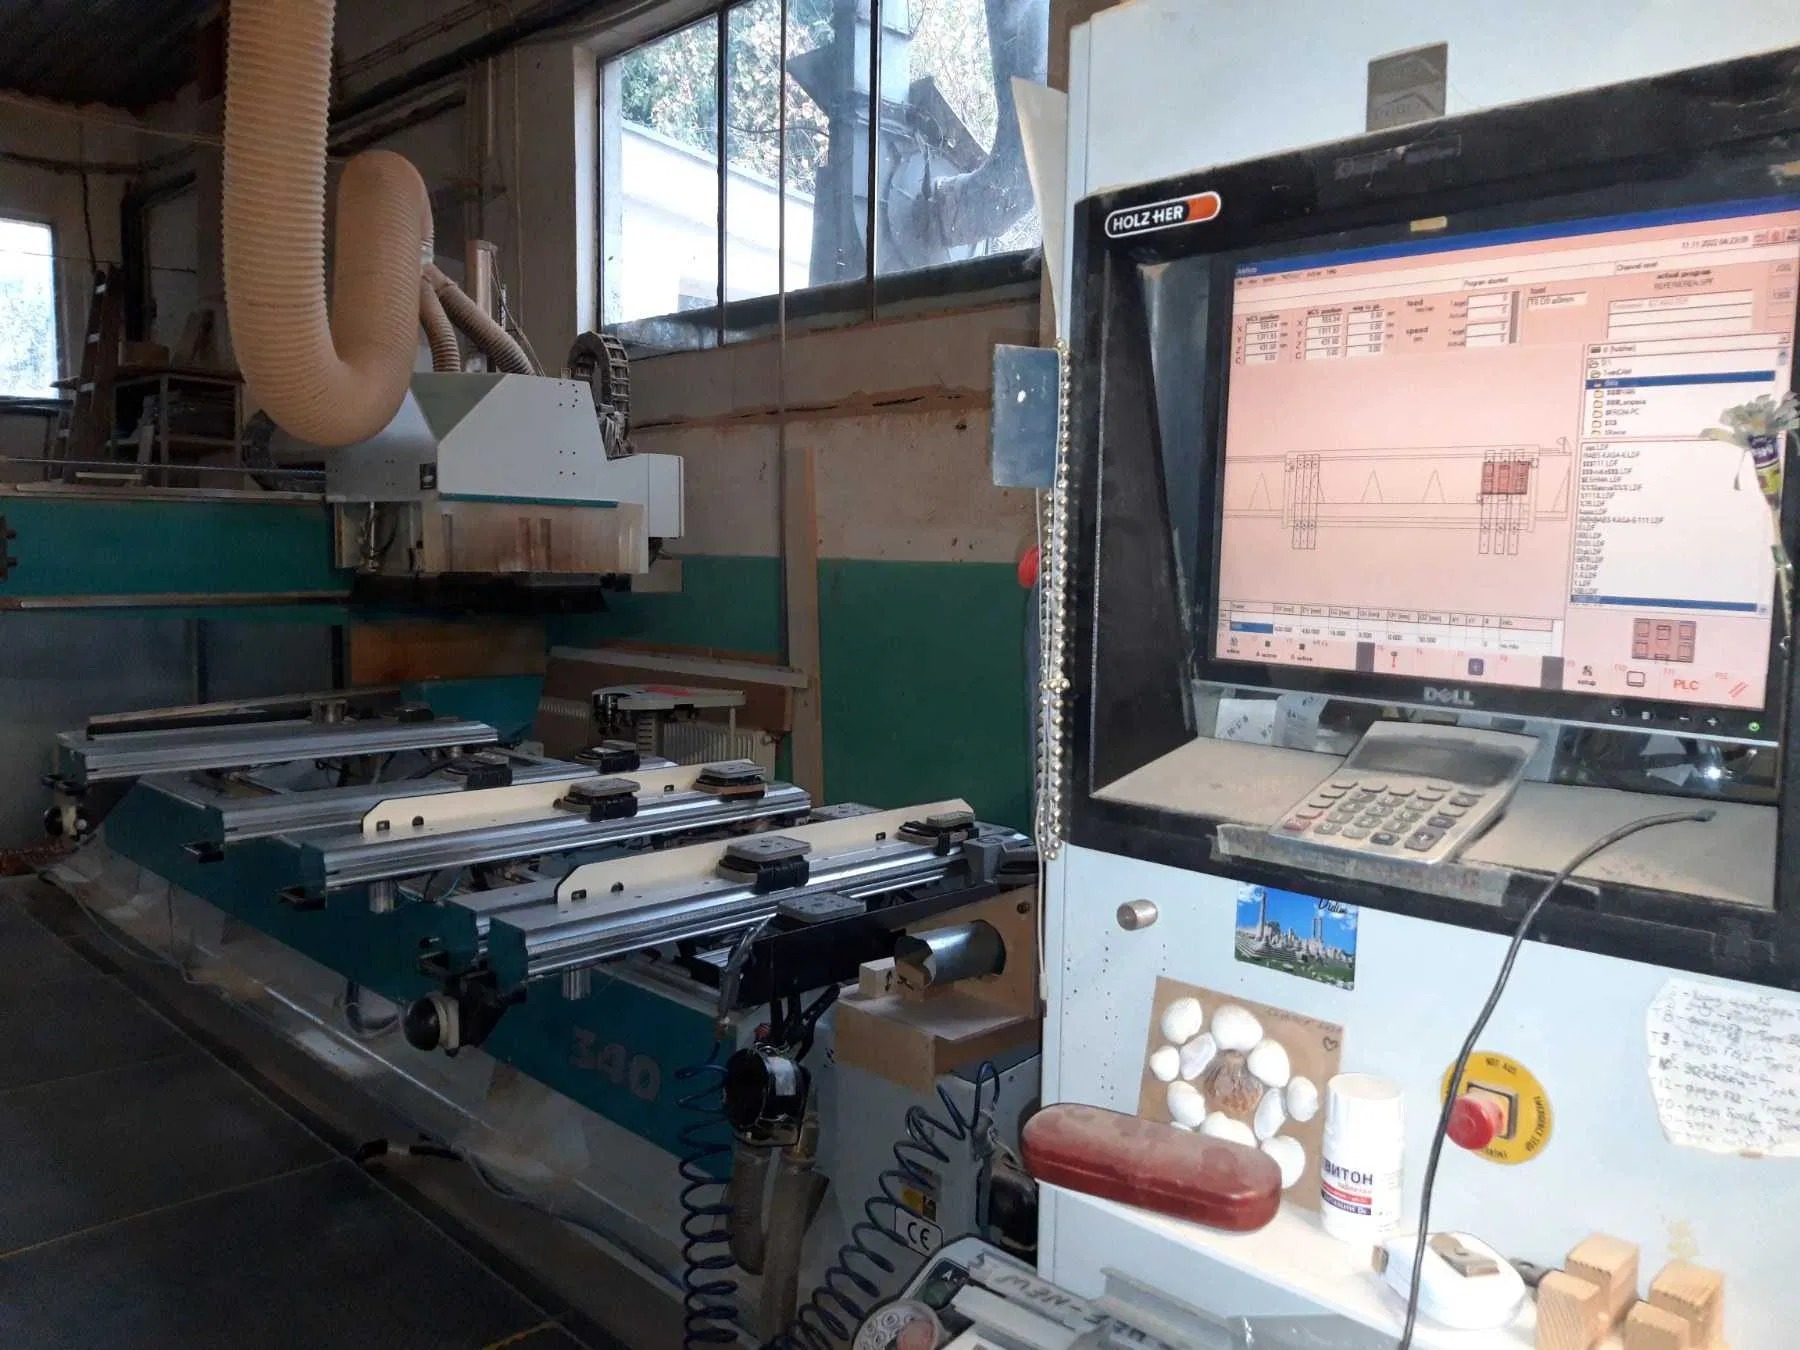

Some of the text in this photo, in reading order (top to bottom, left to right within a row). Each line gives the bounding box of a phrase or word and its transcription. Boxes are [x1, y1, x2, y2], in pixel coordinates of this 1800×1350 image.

[1423, 686, 1475, 706] DELL
[1673, 679, 1699, 691] PLC
[569, 1024, 661, 1101] 340
[907, 1221, 931, 1252] CE
